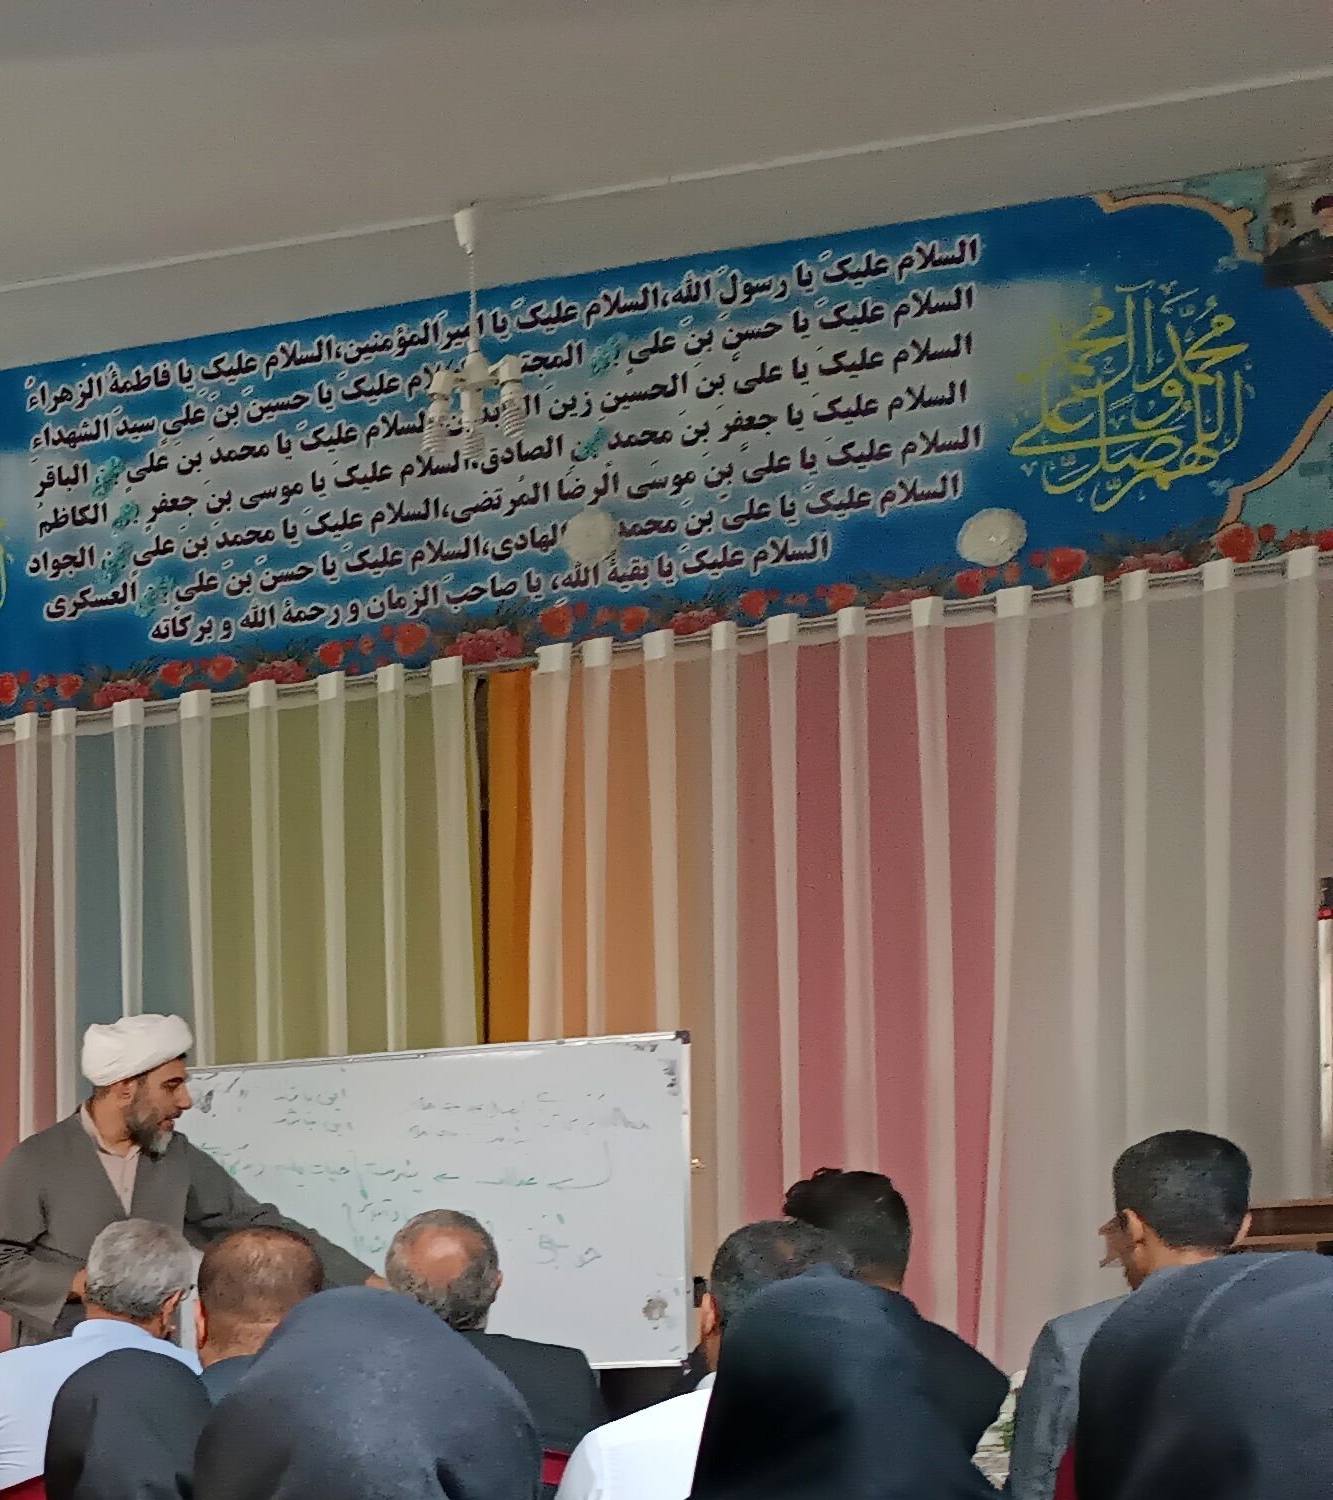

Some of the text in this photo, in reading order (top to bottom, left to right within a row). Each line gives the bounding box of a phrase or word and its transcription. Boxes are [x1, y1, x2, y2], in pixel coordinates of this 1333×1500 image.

[897, 238, 979, 282] السلام
[795, 262, 814, 293] یا
[893, 285, 975, 329] السلام
[491, 311, 510, 340] یا
[792, 309, 811, 340] یا
[893, 331, 973, 374] السلام
[178, 362, 195, 390] یا
[792, 355, 810, 386] یا
[316, 381, 335, 410] یا
[888, 379, 967, 421] السلام
[365, 410, 426, 449] لسلام
[787, 402, 805, 432] یا
[276, 432, 293, 460] یا
[902, 424, 982, 466] السلام
[800, 446, 819, 475] یا
[311, 470, 326, 498] یا
[880, 473, 960, 515] السلام
[780, 494, 797, 524] یا
[282, 517, 299, 545] یا
[28, 545, 95, 579] الجواد
[321, 554, 339, 582] یا
[752, 534, 829, 574] السلام
[657, 555, 674, 585] یا
[45, 580, 137, 619] العسکری
[525, 571, 543, 600] یا
[347, 602, 360, 624] و
[367, 583, 440, 620] الزمان
[219, 620, 233, 641] و
